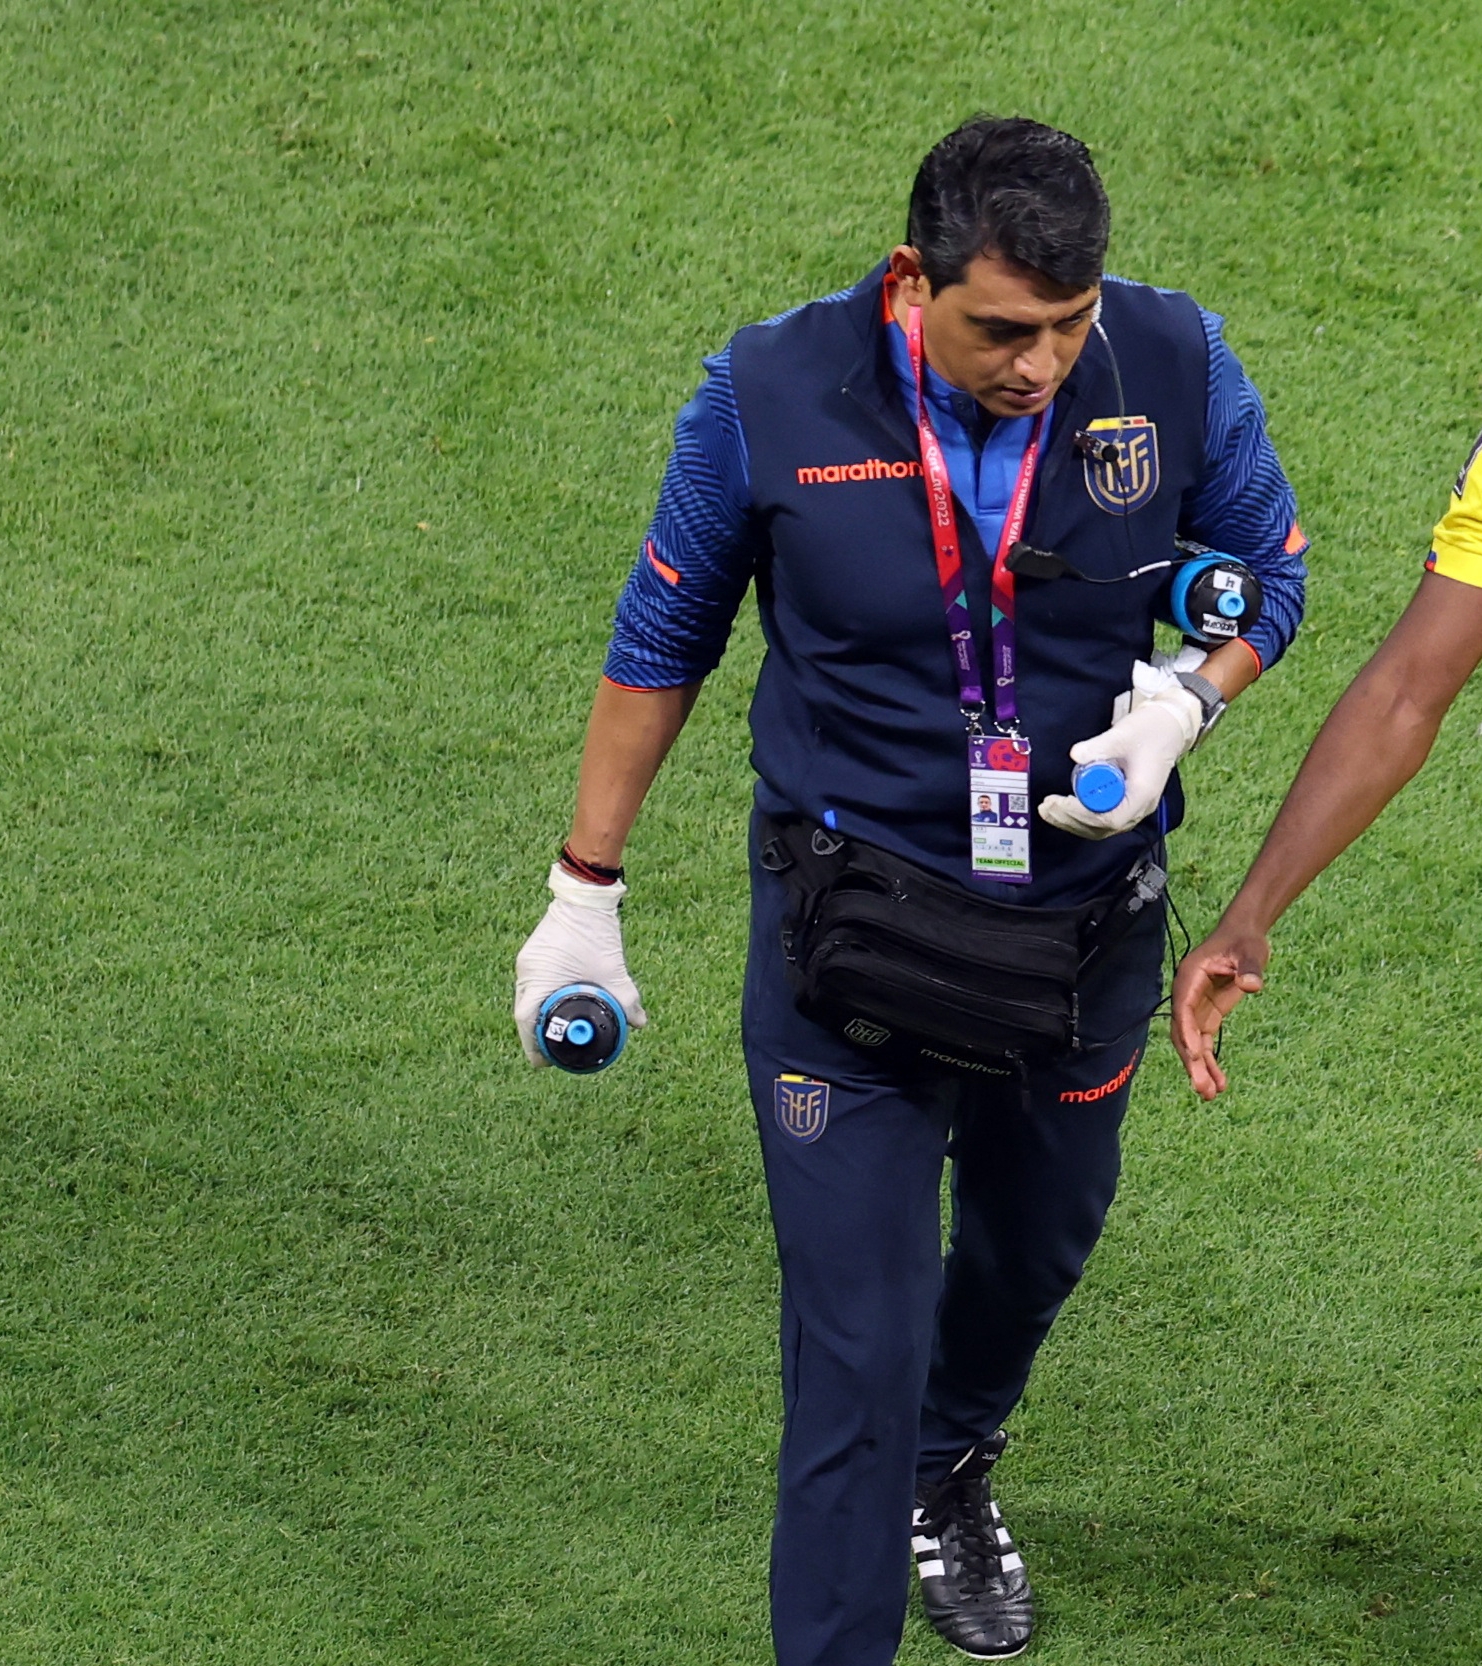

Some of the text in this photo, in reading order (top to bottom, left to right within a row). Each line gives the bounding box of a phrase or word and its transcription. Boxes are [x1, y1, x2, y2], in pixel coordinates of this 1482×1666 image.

[797, 458, 924, 484] marathon
[1013, 478, 1030, 520] WORLD
[1024, 453, 1035, 477] CUP
[994, 858, 1025, 866] OFFICIAL
[920, 1048, 1012, 1076] marathon
